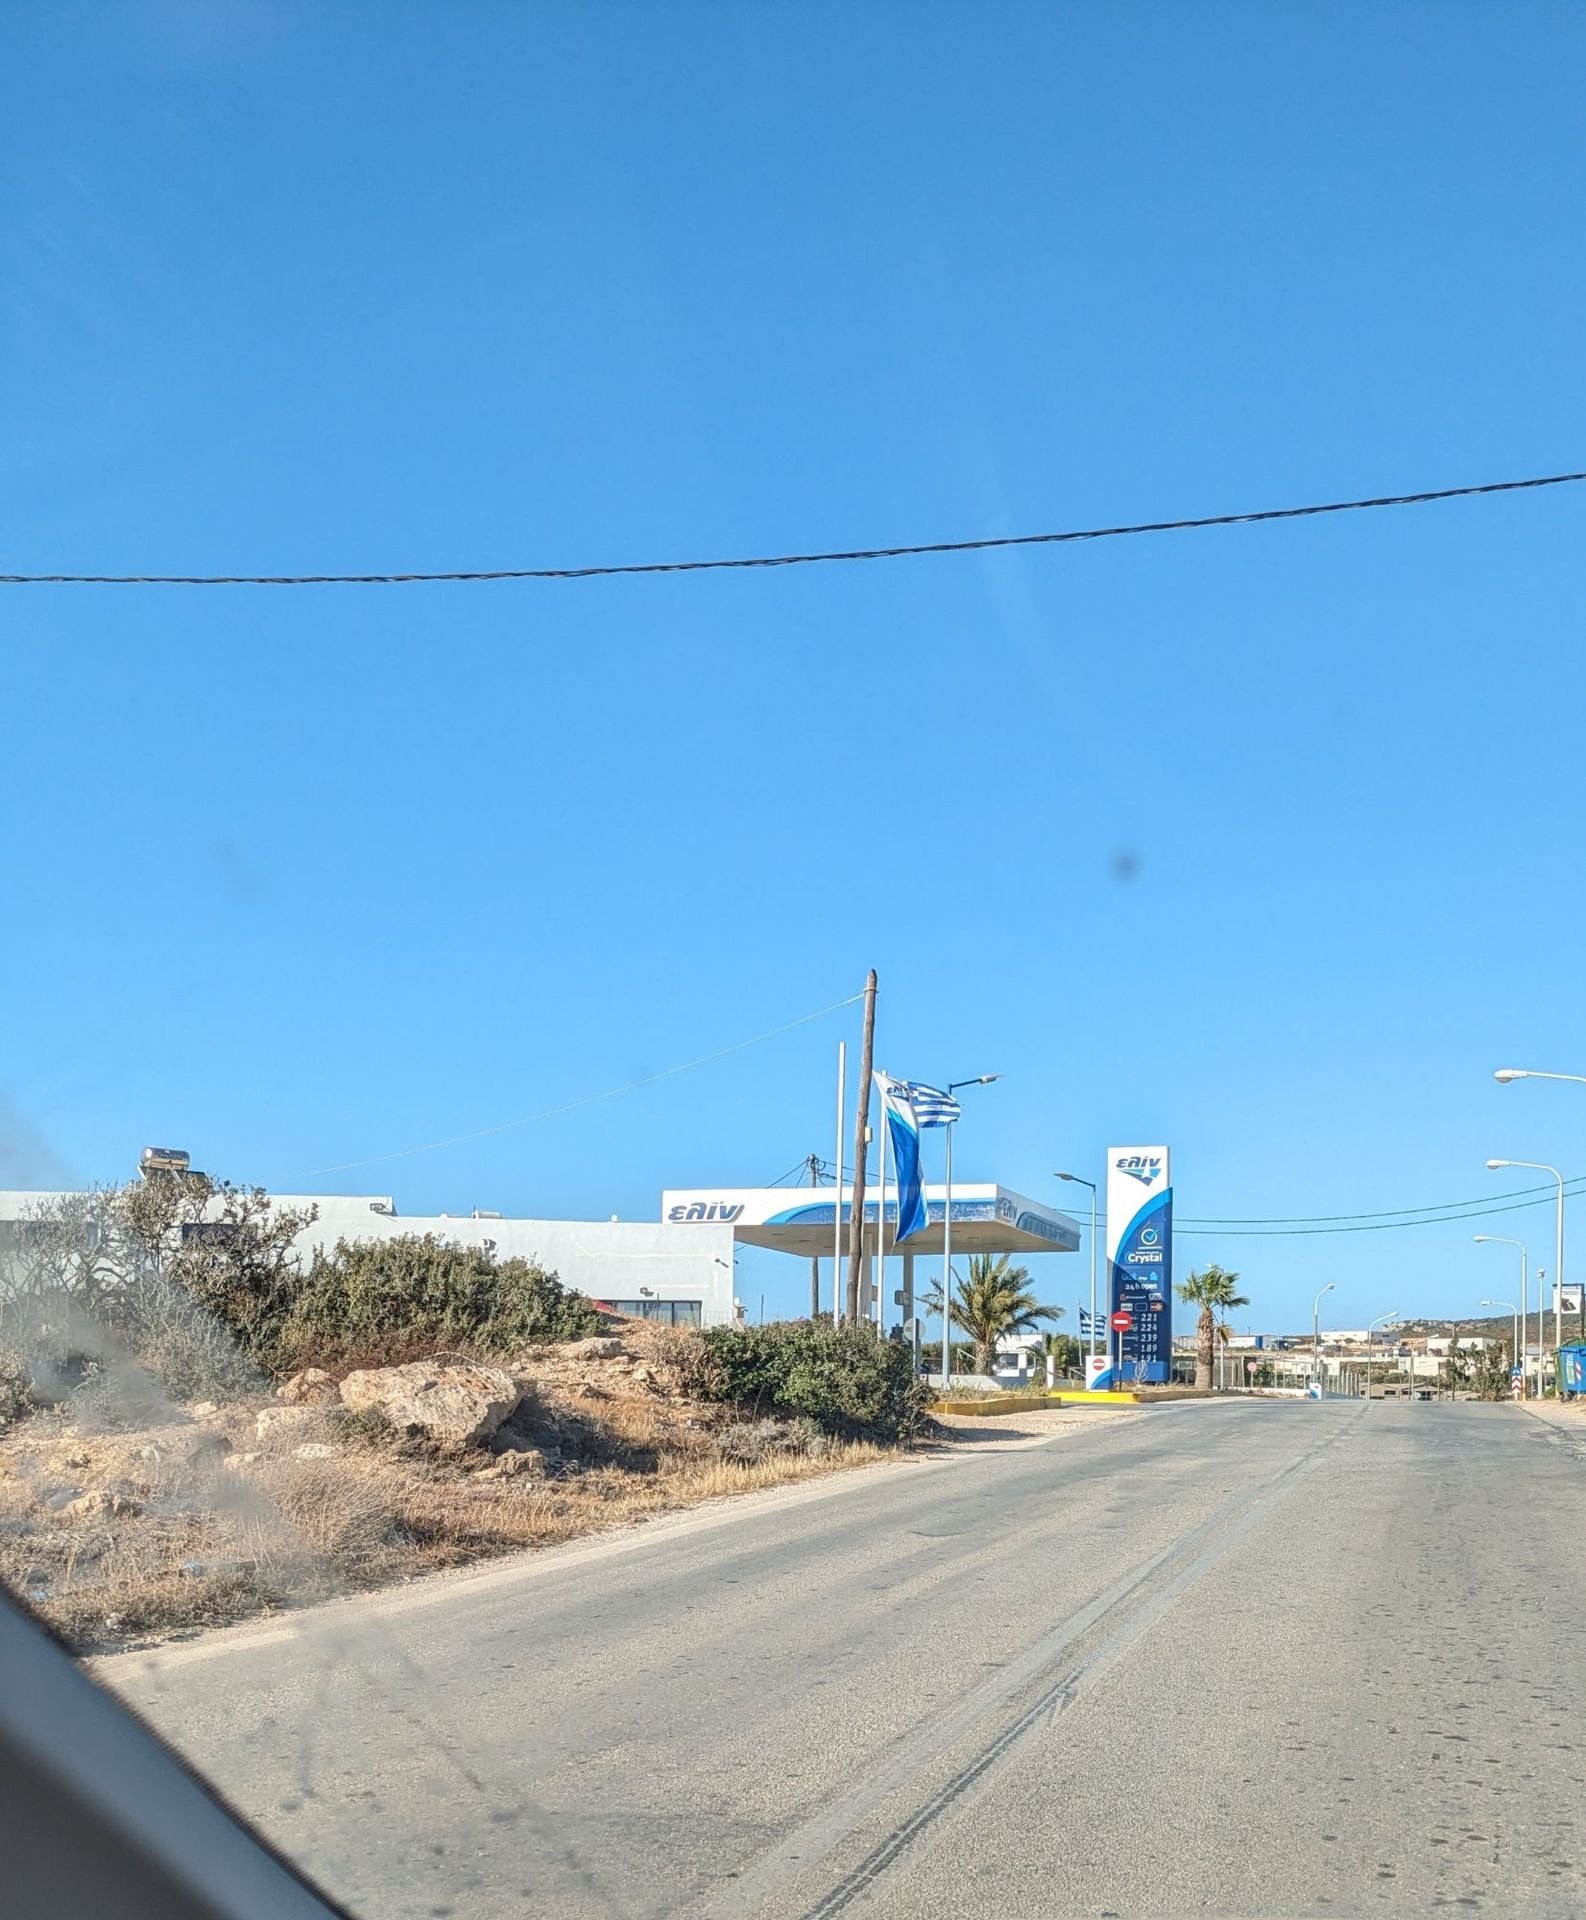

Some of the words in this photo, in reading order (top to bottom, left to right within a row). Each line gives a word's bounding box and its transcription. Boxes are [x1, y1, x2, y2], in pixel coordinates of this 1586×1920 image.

[1127, 1252, 1163, 1264] Crystal
[1140, 1333, 1157, 1342] 239
[1140, 1344, 1157, 1352] 189
